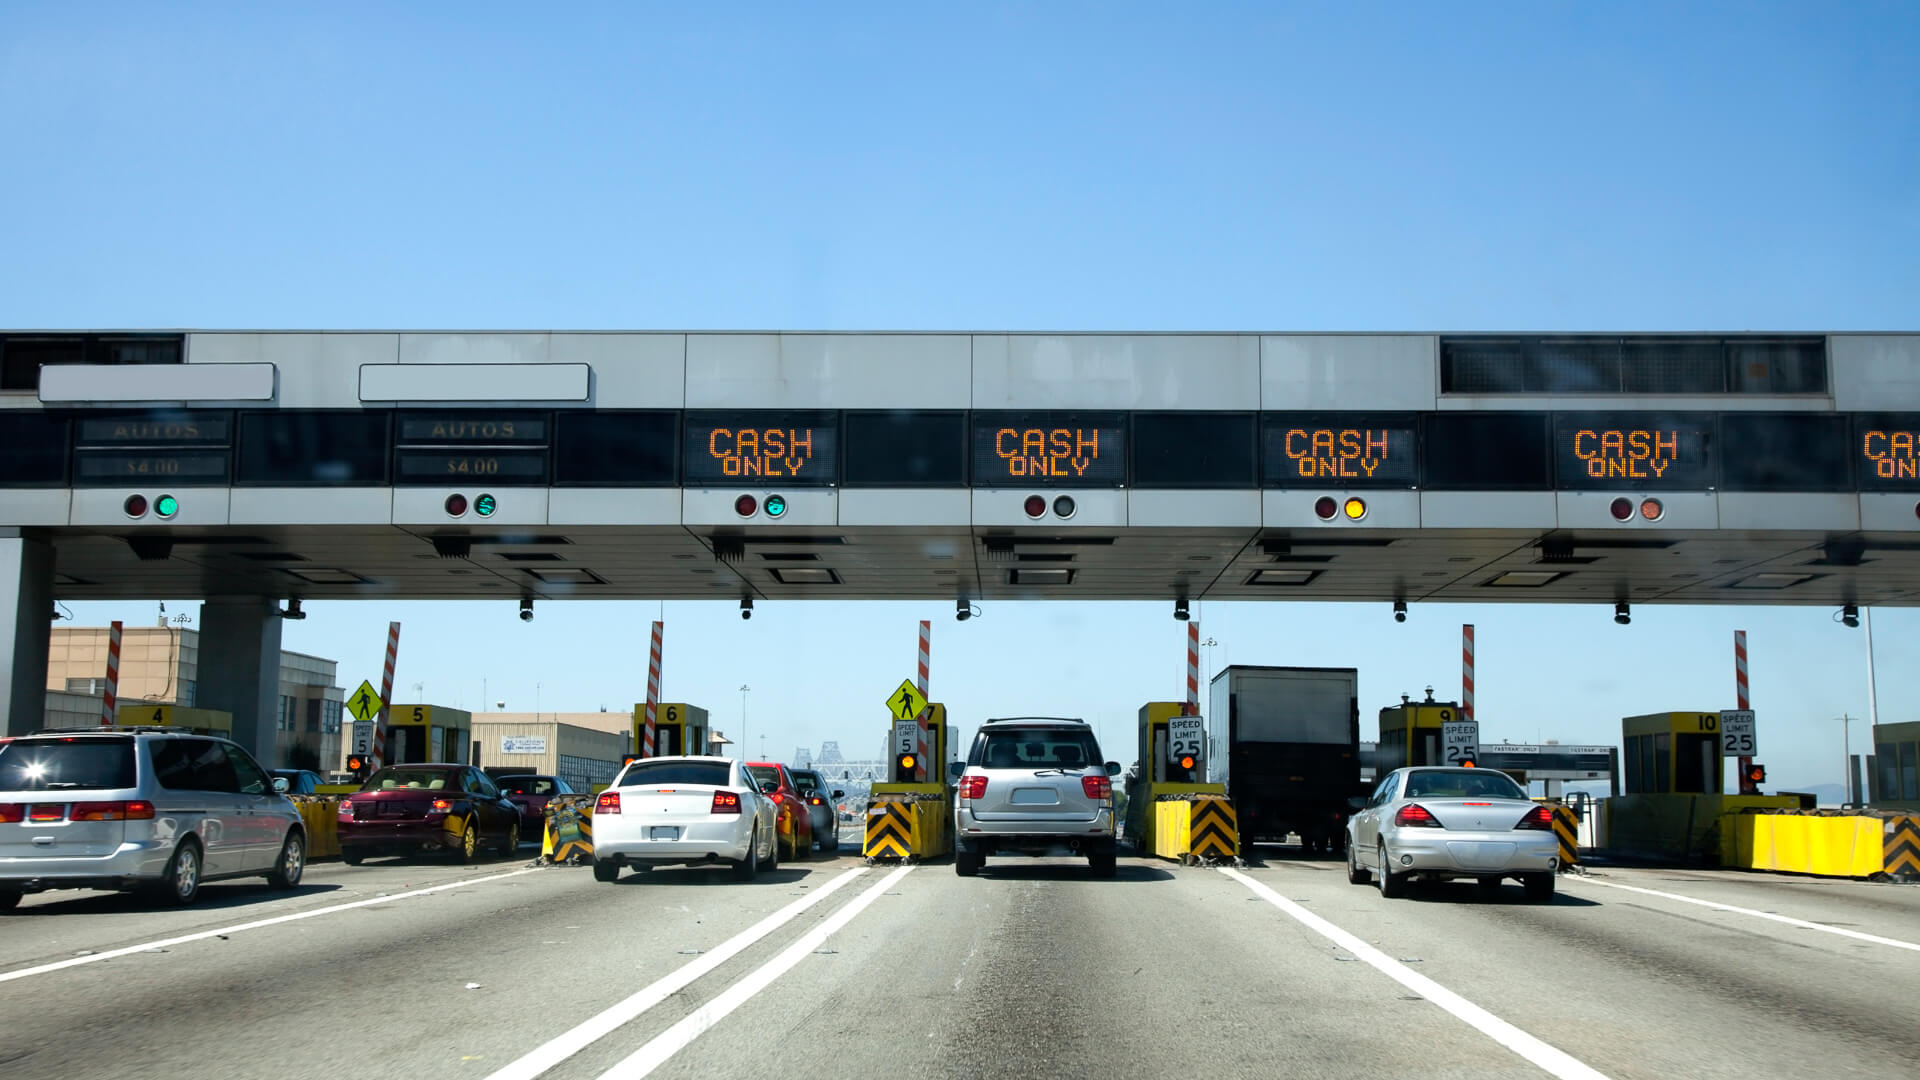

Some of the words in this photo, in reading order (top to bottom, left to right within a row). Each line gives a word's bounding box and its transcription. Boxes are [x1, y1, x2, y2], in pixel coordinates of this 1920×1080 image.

[114, 423, 199, 439] AUTOS
[432, 421, 515, 438] AUTOS
[710, 428, 812, 458] CASH
[996, 428, 1098, 458] CASH
[1285, 429, 1388, 459] CASH
[1575, 430, 1677, 460] CASH
[1864, 431, 1920, 460] CA
[448, 458, 498, 474] $4.00
[723, 456, 803, 476] ONLY
[1009, 456, 1089, 476] ONLY
[1298, 457, 1379, 477] ONLY
[1588, 457, 1668, 478] ONLY
[1877, 458, 1920, 478] ON
[152, 707, 163, 723] 4
[413, 707, 423, 722] 5
[666, 705, 677, 721] 6
[928, 706, 935, 720] 7
[1440, 710, 1450, 721] 9
[1723, 714, 1752, 723] SPEED
[1171, 720, 1200, 728] SPEED
[1445, 726, 1476, 734] SPEED
[1699, 715, 1716, 731] 10
[1726, 724, 1749, 732] LIMIT
[1175, 731, 1197, 739] LIMIT
[1448, 735, 1473, 743] LIMIT
[1725, 734, 1753, 751] 25
[358, 739, 367, 753] 5
[902, 739, 911, 752] 5
[1173, 740, 1200, 758] 25
[1447, 745, 1476, 762] 25
